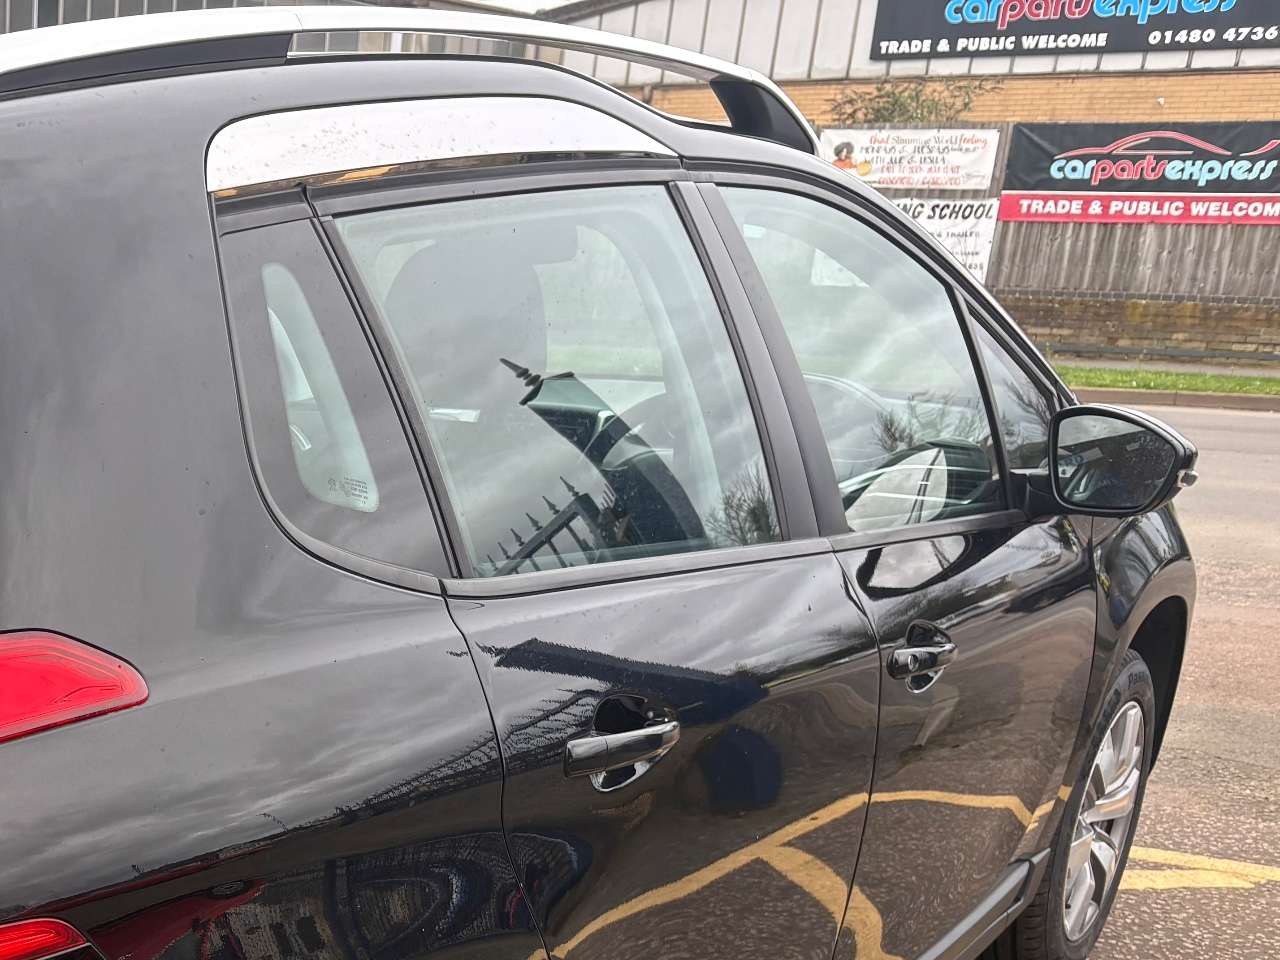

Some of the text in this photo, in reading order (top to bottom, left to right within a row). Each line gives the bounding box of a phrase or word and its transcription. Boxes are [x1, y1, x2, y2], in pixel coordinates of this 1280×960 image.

[879, 26, 1279, 54] TRADE & PUBLIC WELCOME 01480 4736
[1050, 154, 1277, 187] carpartsexpress
[927, 203, 993, 219] SCHOOL
[1019, 199, 1280, 217] TRADE & PUBLIC WELCOM
